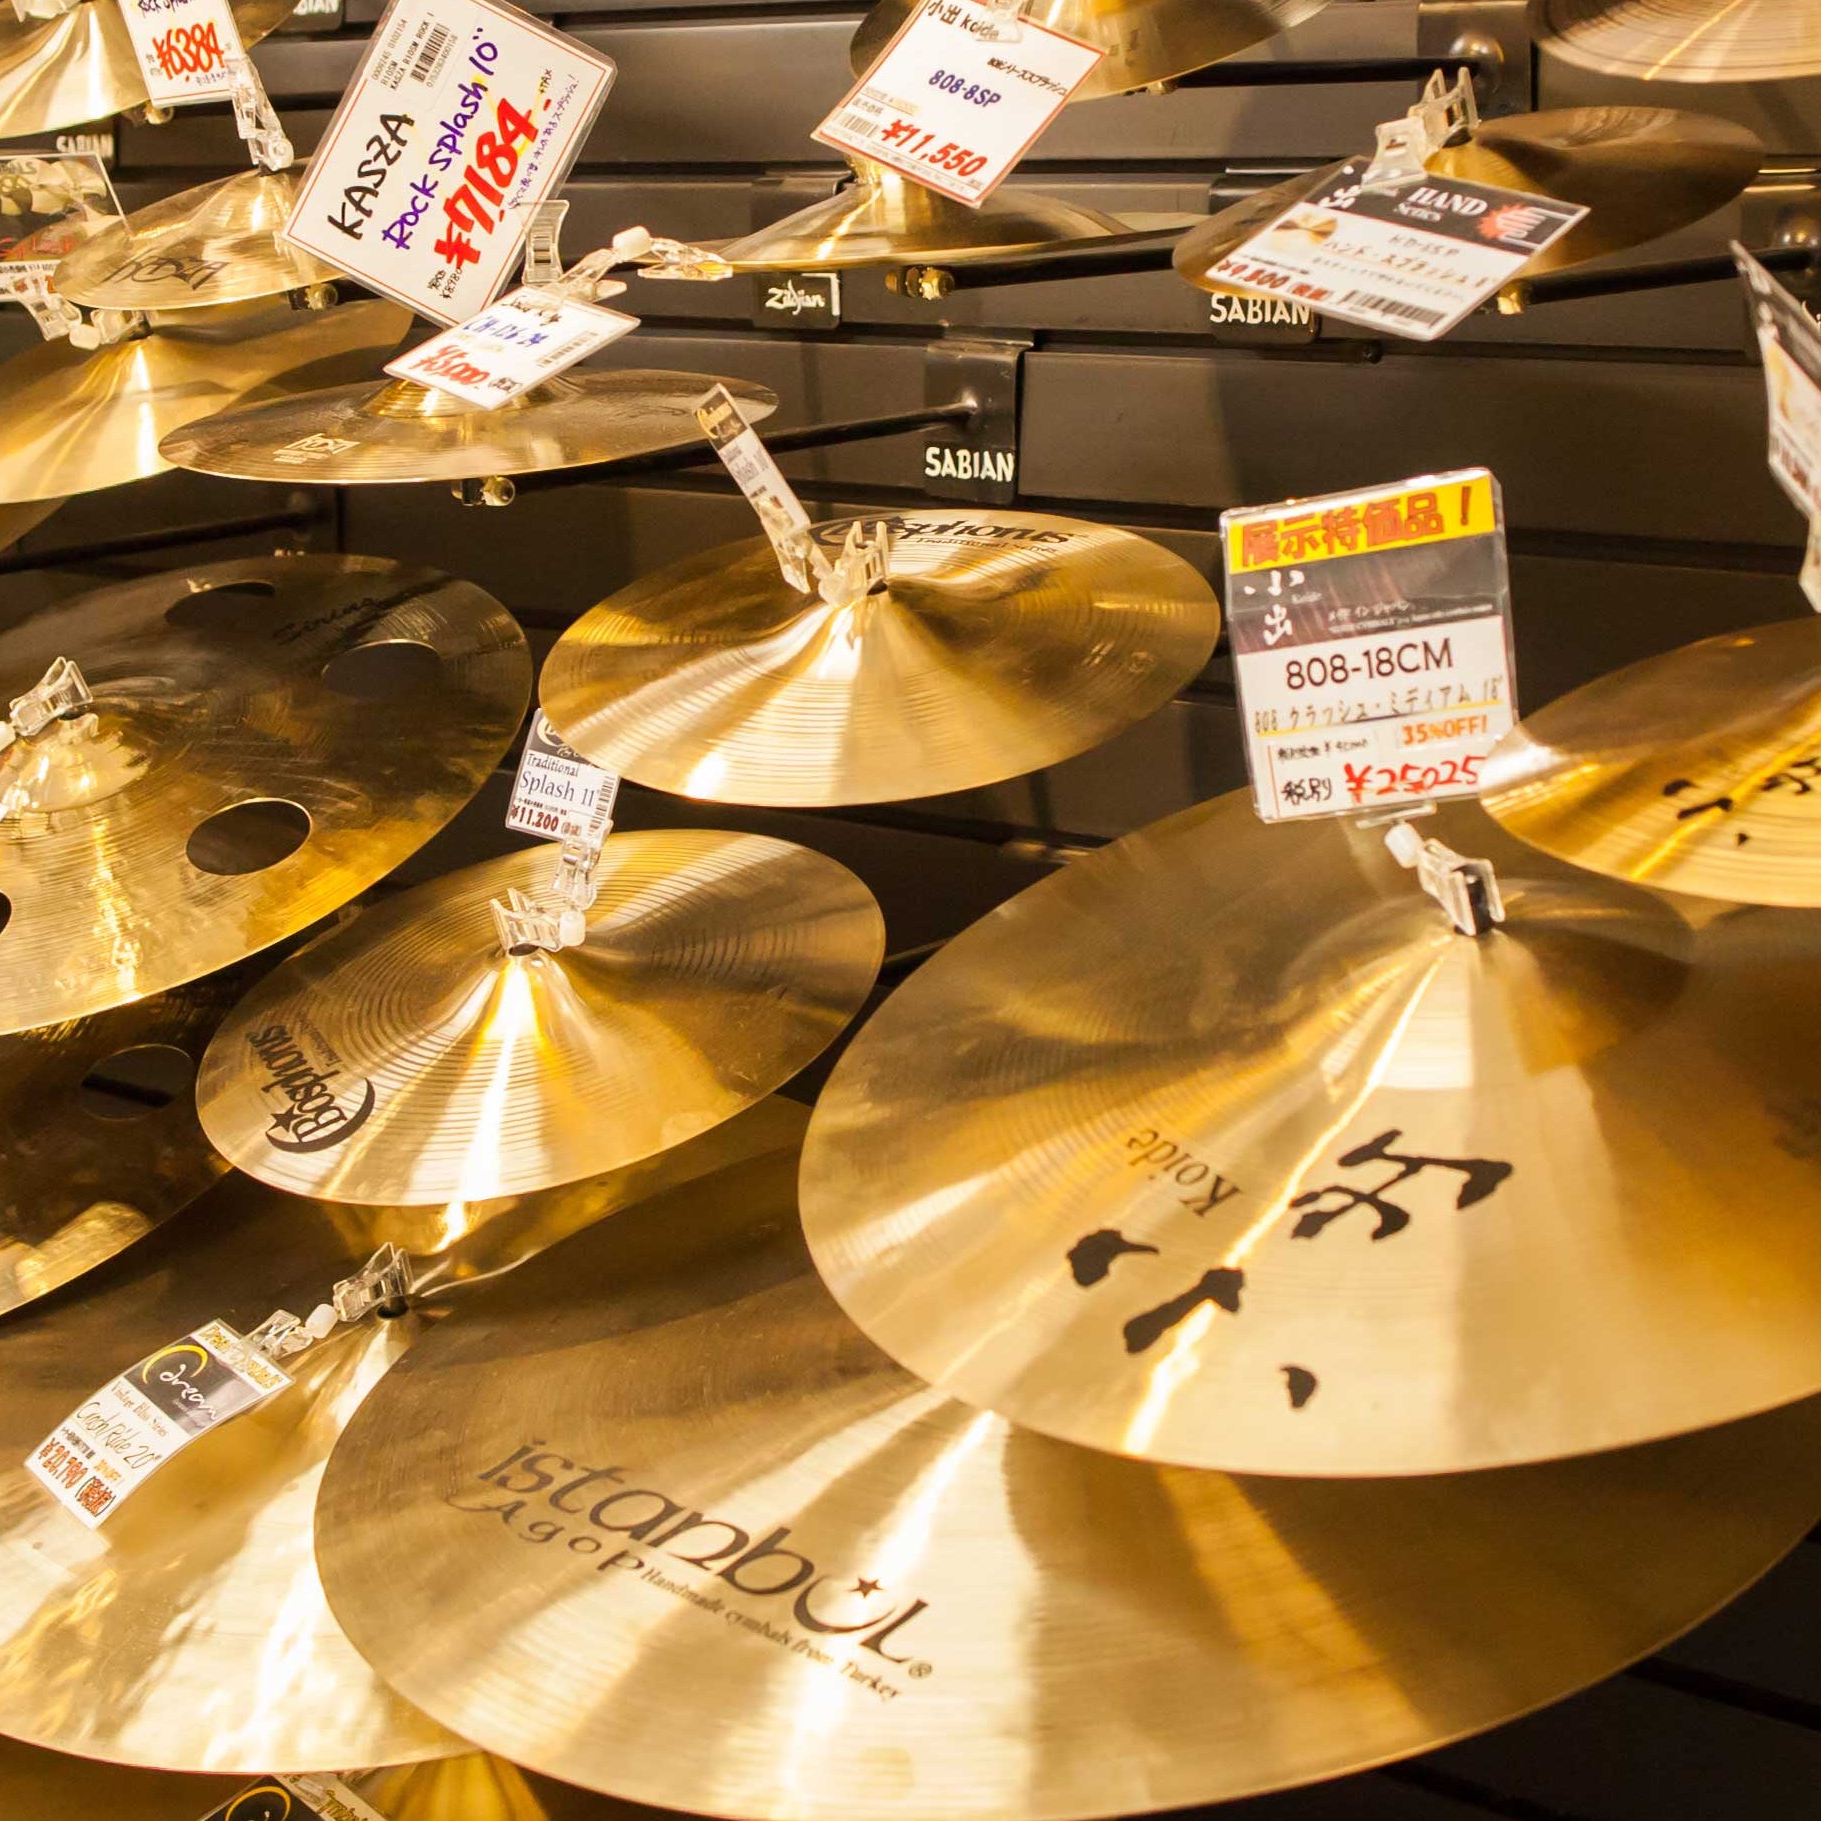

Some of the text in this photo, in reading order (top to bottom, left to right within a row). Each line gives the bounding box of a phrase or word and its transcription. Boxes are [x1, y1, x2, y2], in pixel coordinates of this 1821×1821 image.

[929, 69, 1002, 108] 808-8SP
[880, 118, 989, 178] ¥11,550
[327, 113, 416, 241] KASZA
[1408, 186, 1491, 217] HAND
[765, 279, 826, 315] Zildjian
[1209, 292, 1313, 327] SABIAN
[924, 446, 1015, 483] SABIAN
[1286, 637, 1454, 691] 808-18CM
[528, 753, 580, 778] Traditional
[519, 770, 575, 802] Splash
[1125, 1126, 1246, 1219] Koide
[159, 1363, 219, 1421] dream
[445, 1498, 646, 1573] Agop
